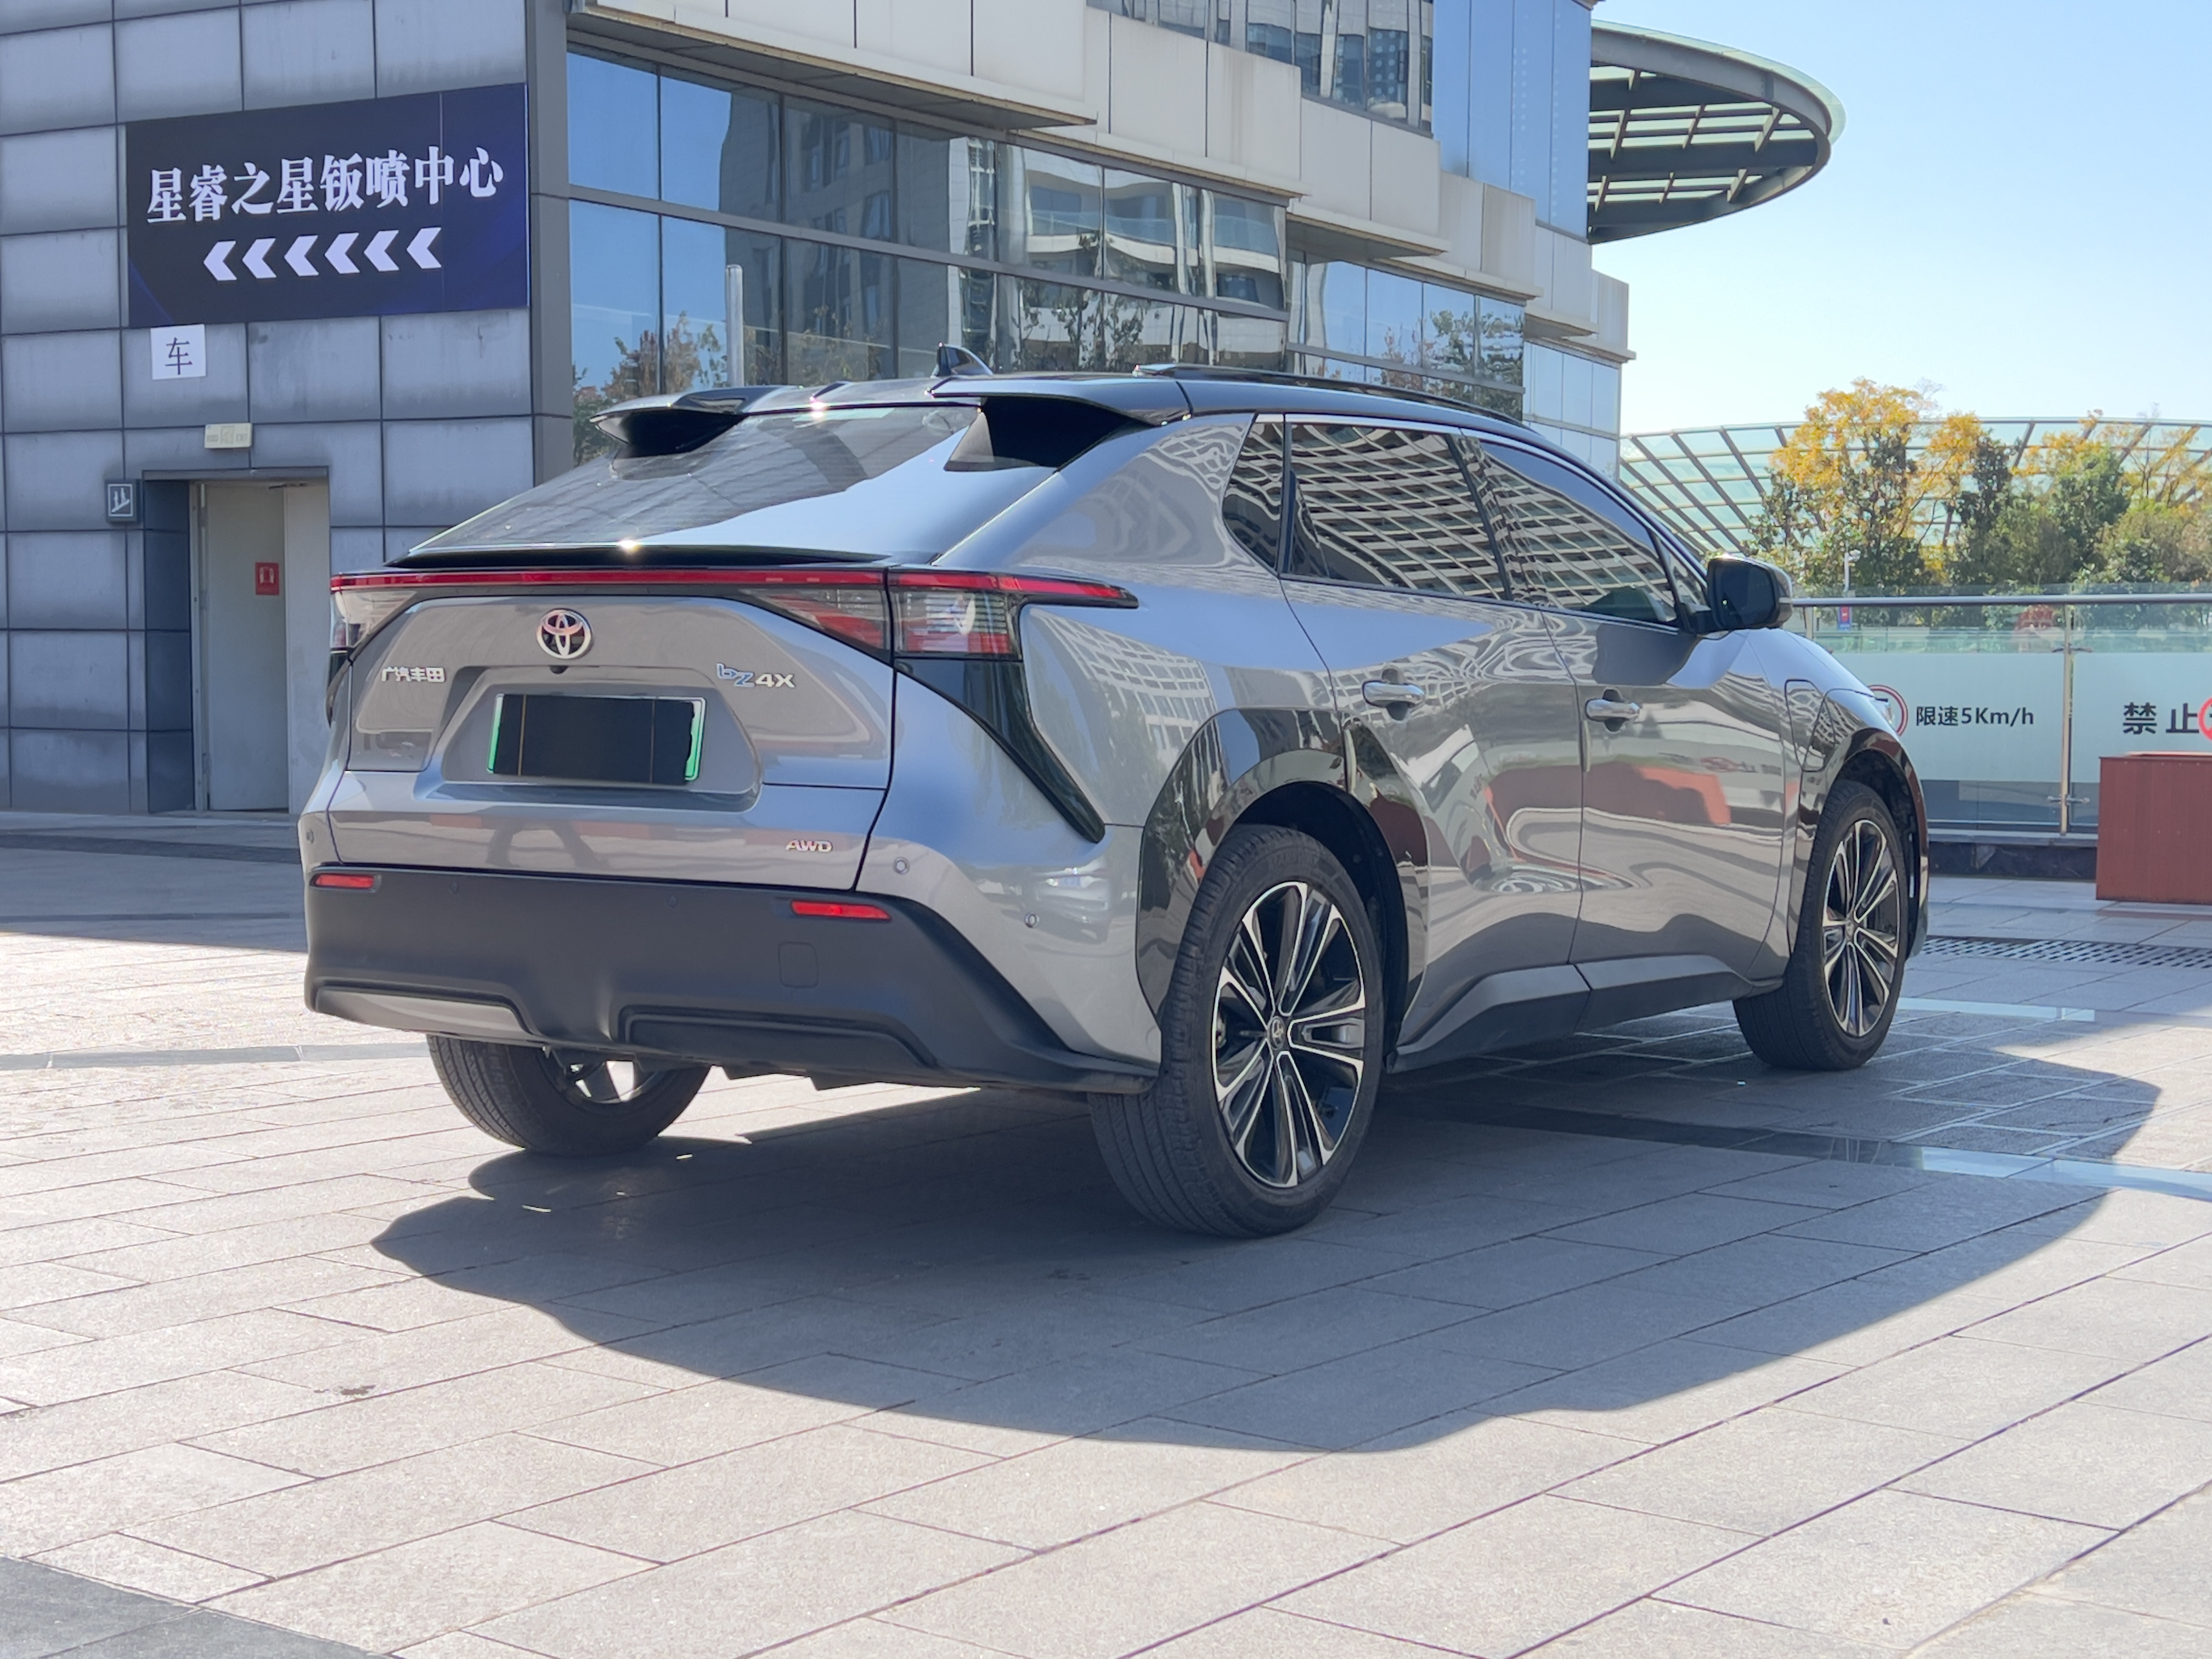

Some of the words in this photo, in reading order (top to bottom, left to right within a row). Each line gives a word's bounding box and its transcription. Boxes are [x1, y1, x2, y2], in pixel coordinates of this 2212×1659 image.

[148, 145, 504, 223] 星睿之星钣喷中心
[165, 337, 193, 375] 车
[1916, 706, 2034, 726] 限速5Km/h
[2123, 702, 2199, 735] 禁止
[785, 839, 832, 853] AWD
